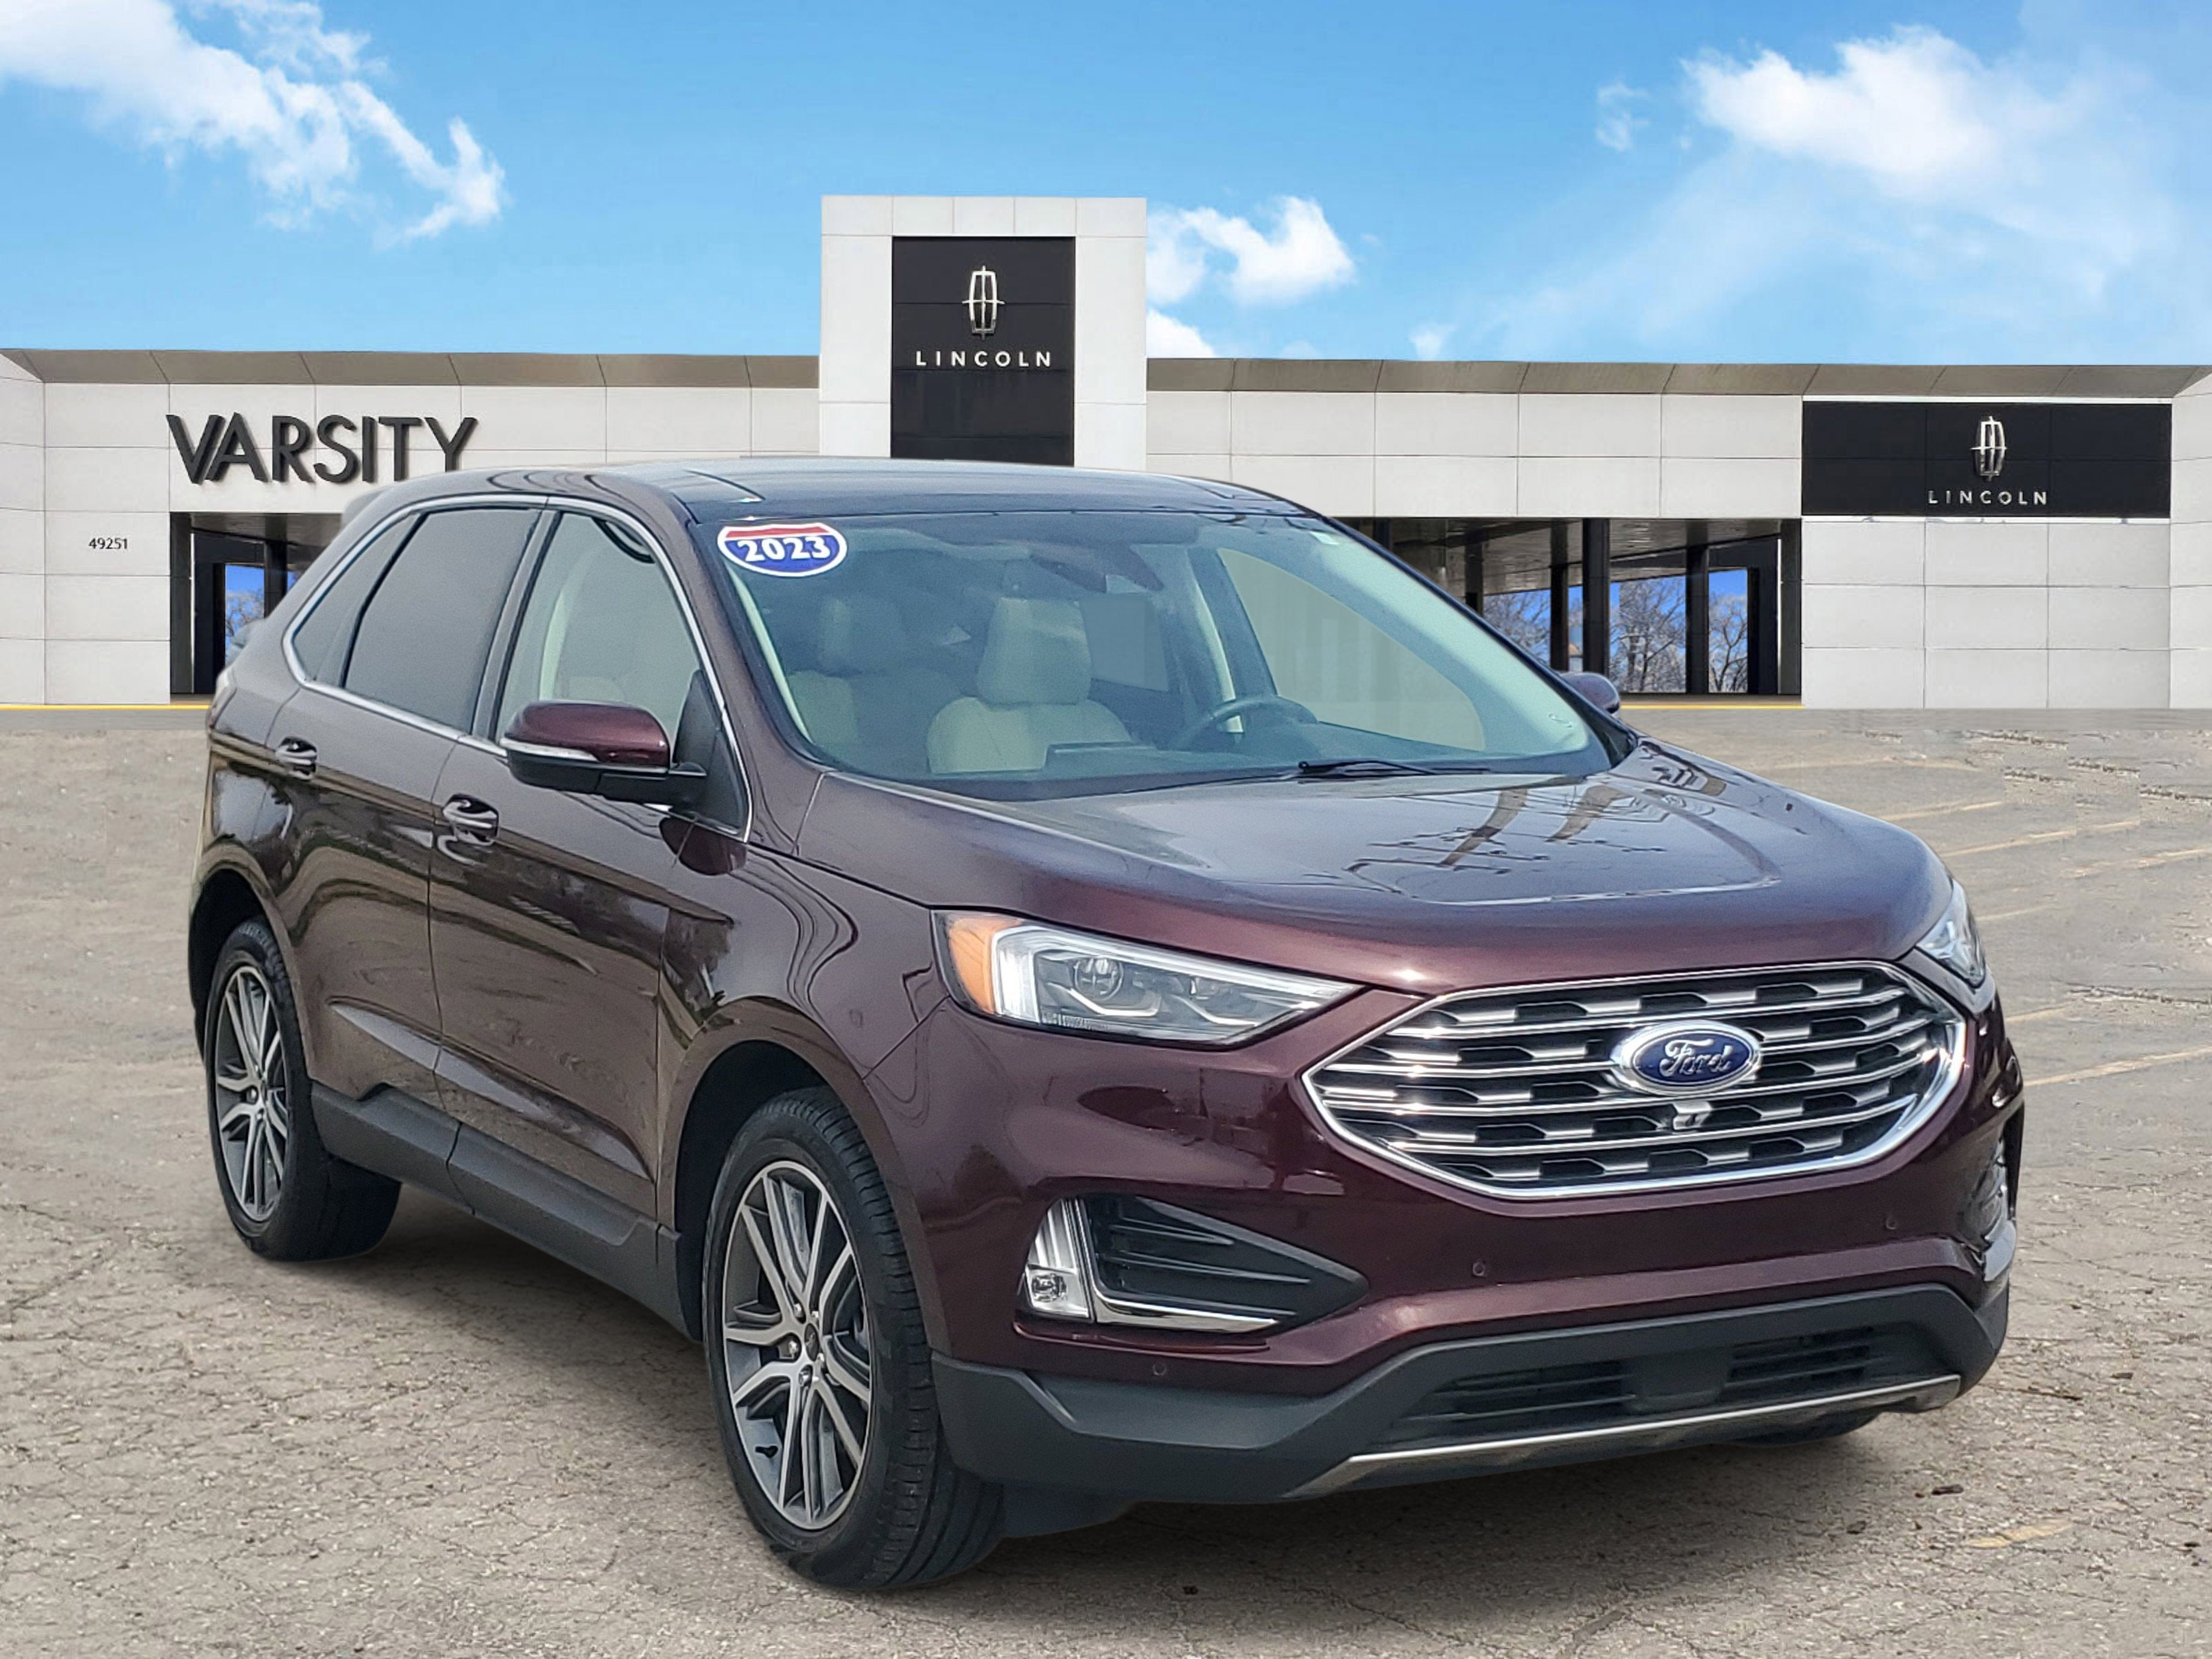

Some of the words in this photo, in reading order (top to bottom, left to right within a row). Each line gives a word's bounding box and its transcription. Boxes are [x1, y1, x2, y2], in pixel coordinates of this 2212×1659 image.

[916, 350, 1051, 368] LINCOLN
[166, 412, 479, 484] VARSITY
[1928, 490, 2048, 505] LINCOLN
[88, 537, 128, 549] 49251
[737, 536, 831, 562] 2023
[1659, 1039, 1733, 1078] Ford
